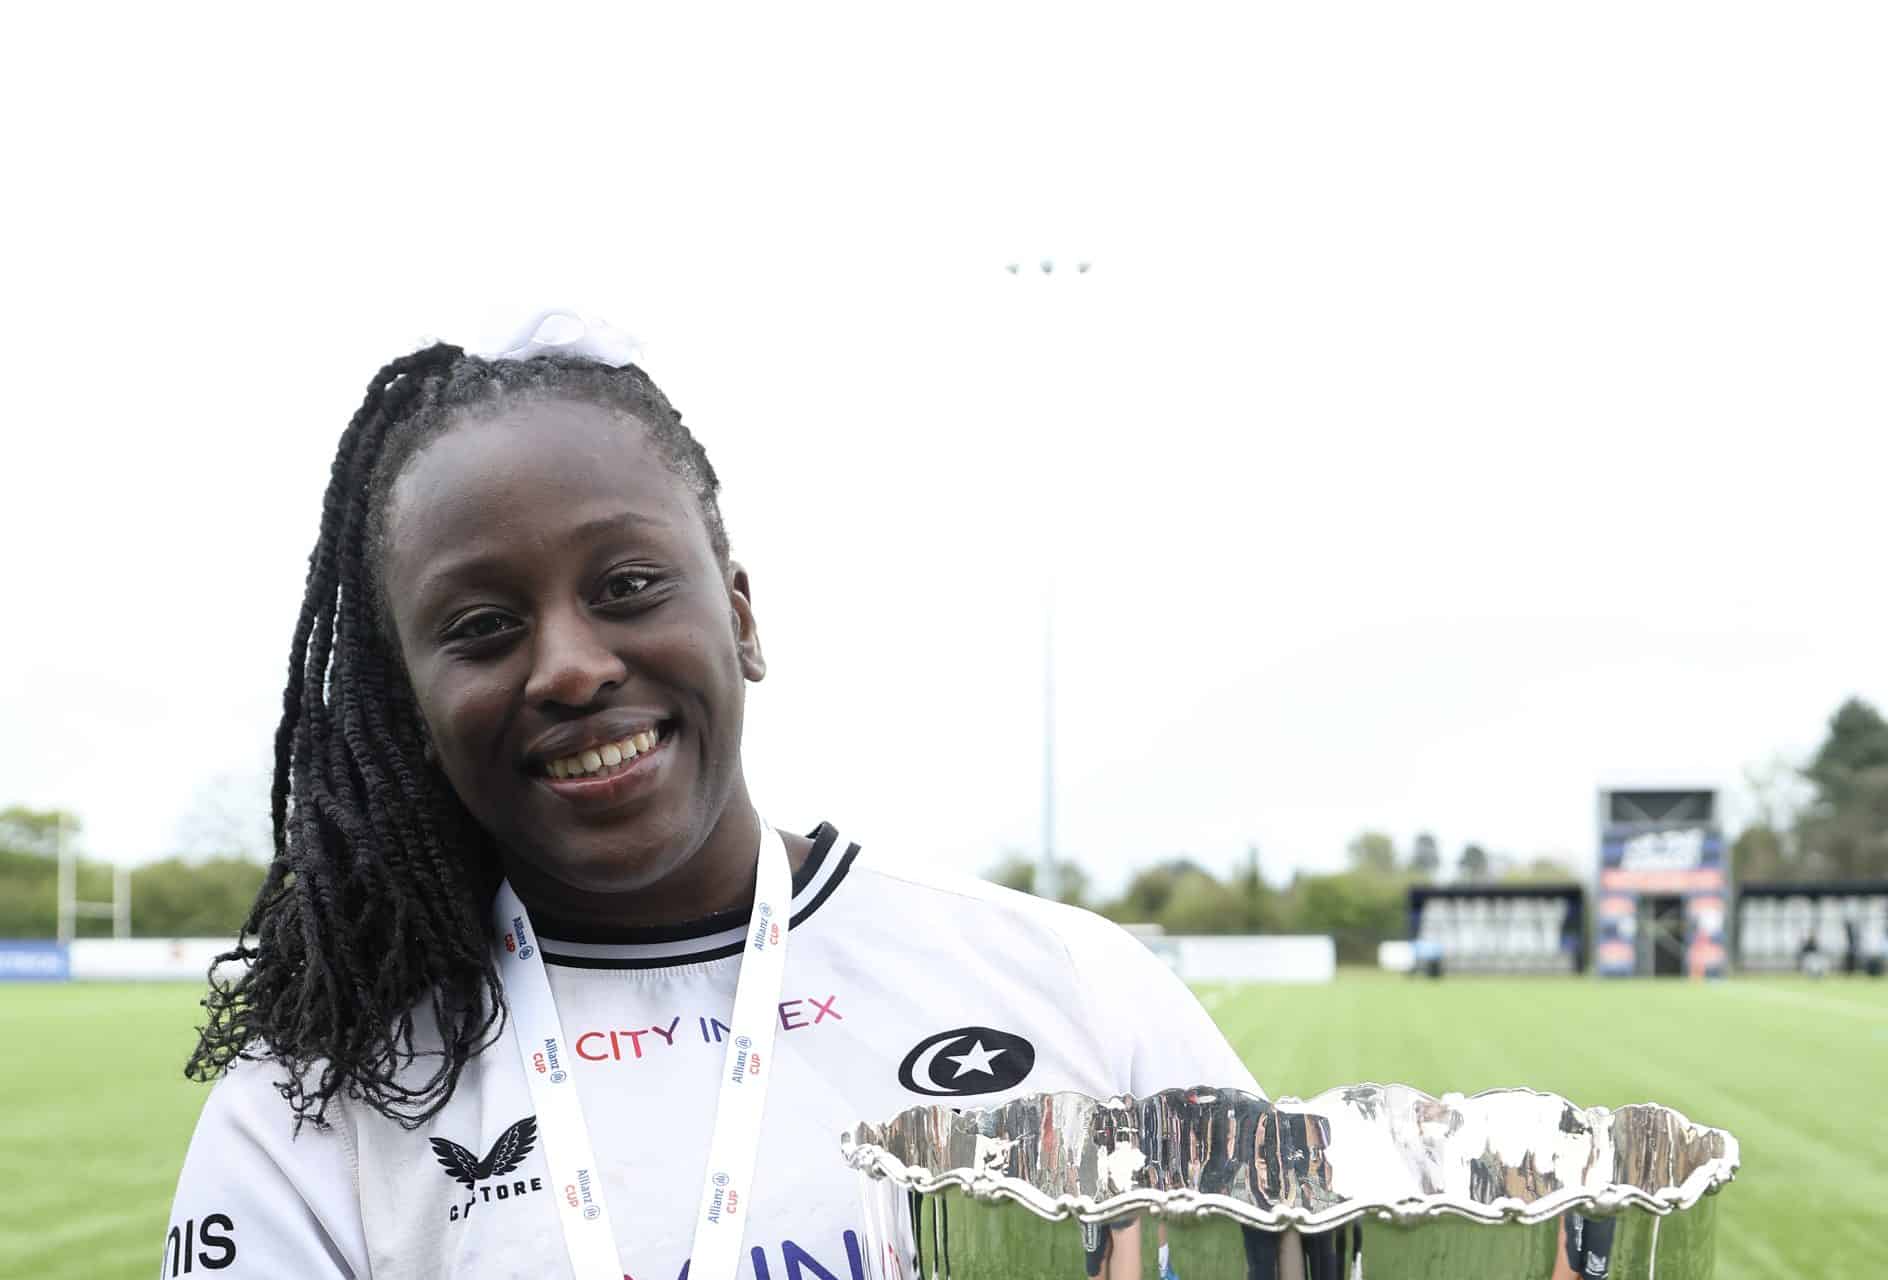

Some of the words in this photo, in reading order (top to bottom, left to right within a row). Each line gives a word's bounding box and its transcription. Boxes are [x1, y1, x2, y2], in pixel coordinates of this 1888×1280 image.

[769, 923, 781, 946] CUP
[576, 1016, 680, 1061] CITY
[700, 995, 843, 1042] INEX
[532, 1052, 547, 1075] CUP
[544, 1037, 560, 1072] Allianz
[731, 1049, 748, 1085] Allianz
[748, 1053, 761, 1076] CUP
[564, 1184, 579, 1208] CUP
[576, 1168, 593, 1206] Allianz
[725, 1189, 739, 1215] CUP
[707, 1187, 725, 1225] Allianz
